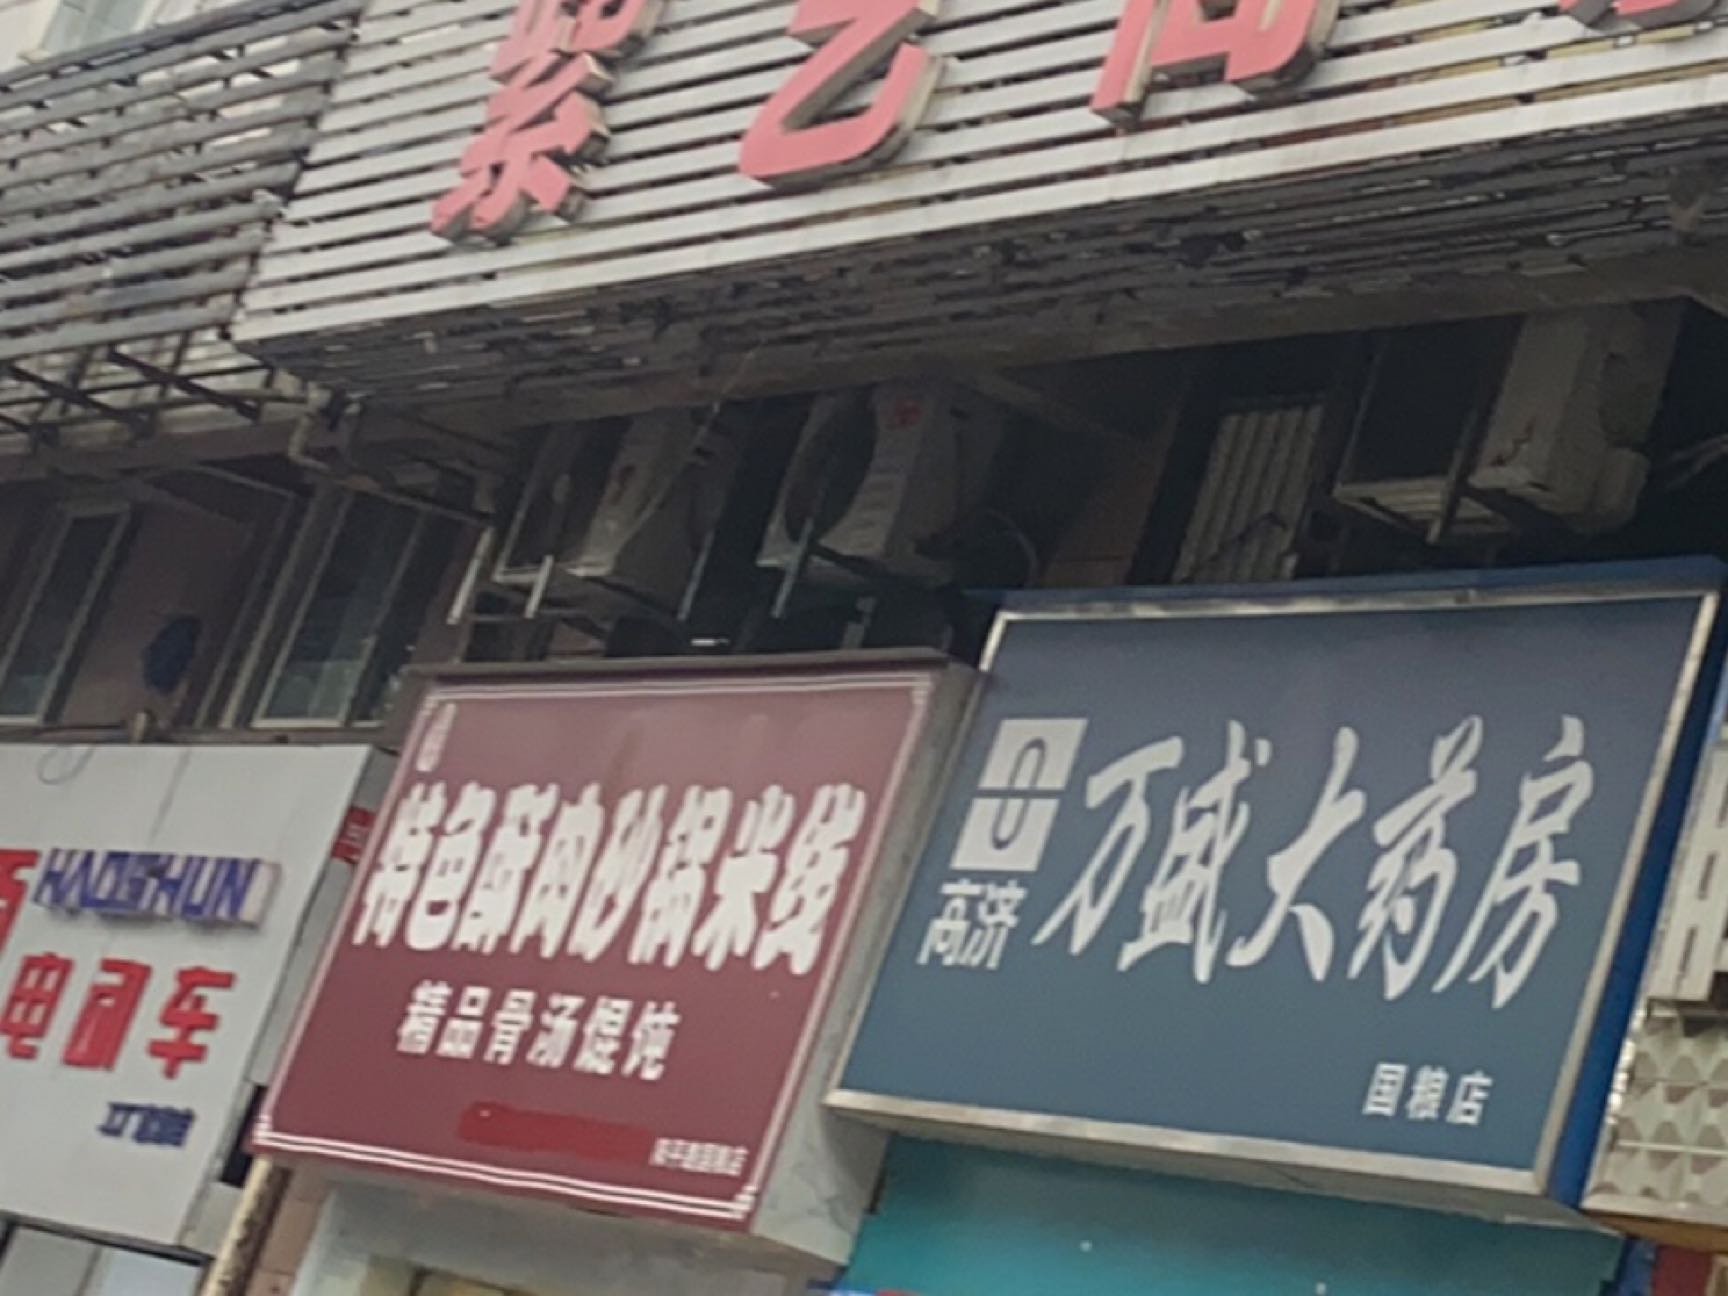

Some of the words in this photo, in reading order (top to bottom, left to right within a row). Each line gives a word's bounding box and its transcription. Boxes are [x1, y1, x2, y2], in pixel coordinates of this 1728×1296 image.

[352, 783, 866, 974] 特色酥肉砂锅米线
[915, 878, 1029, 971] 高济
[1031, 714, 1595, 1009] 万盛大药房
[396, 979, 682, 1081] 精品骨汤馄饨
